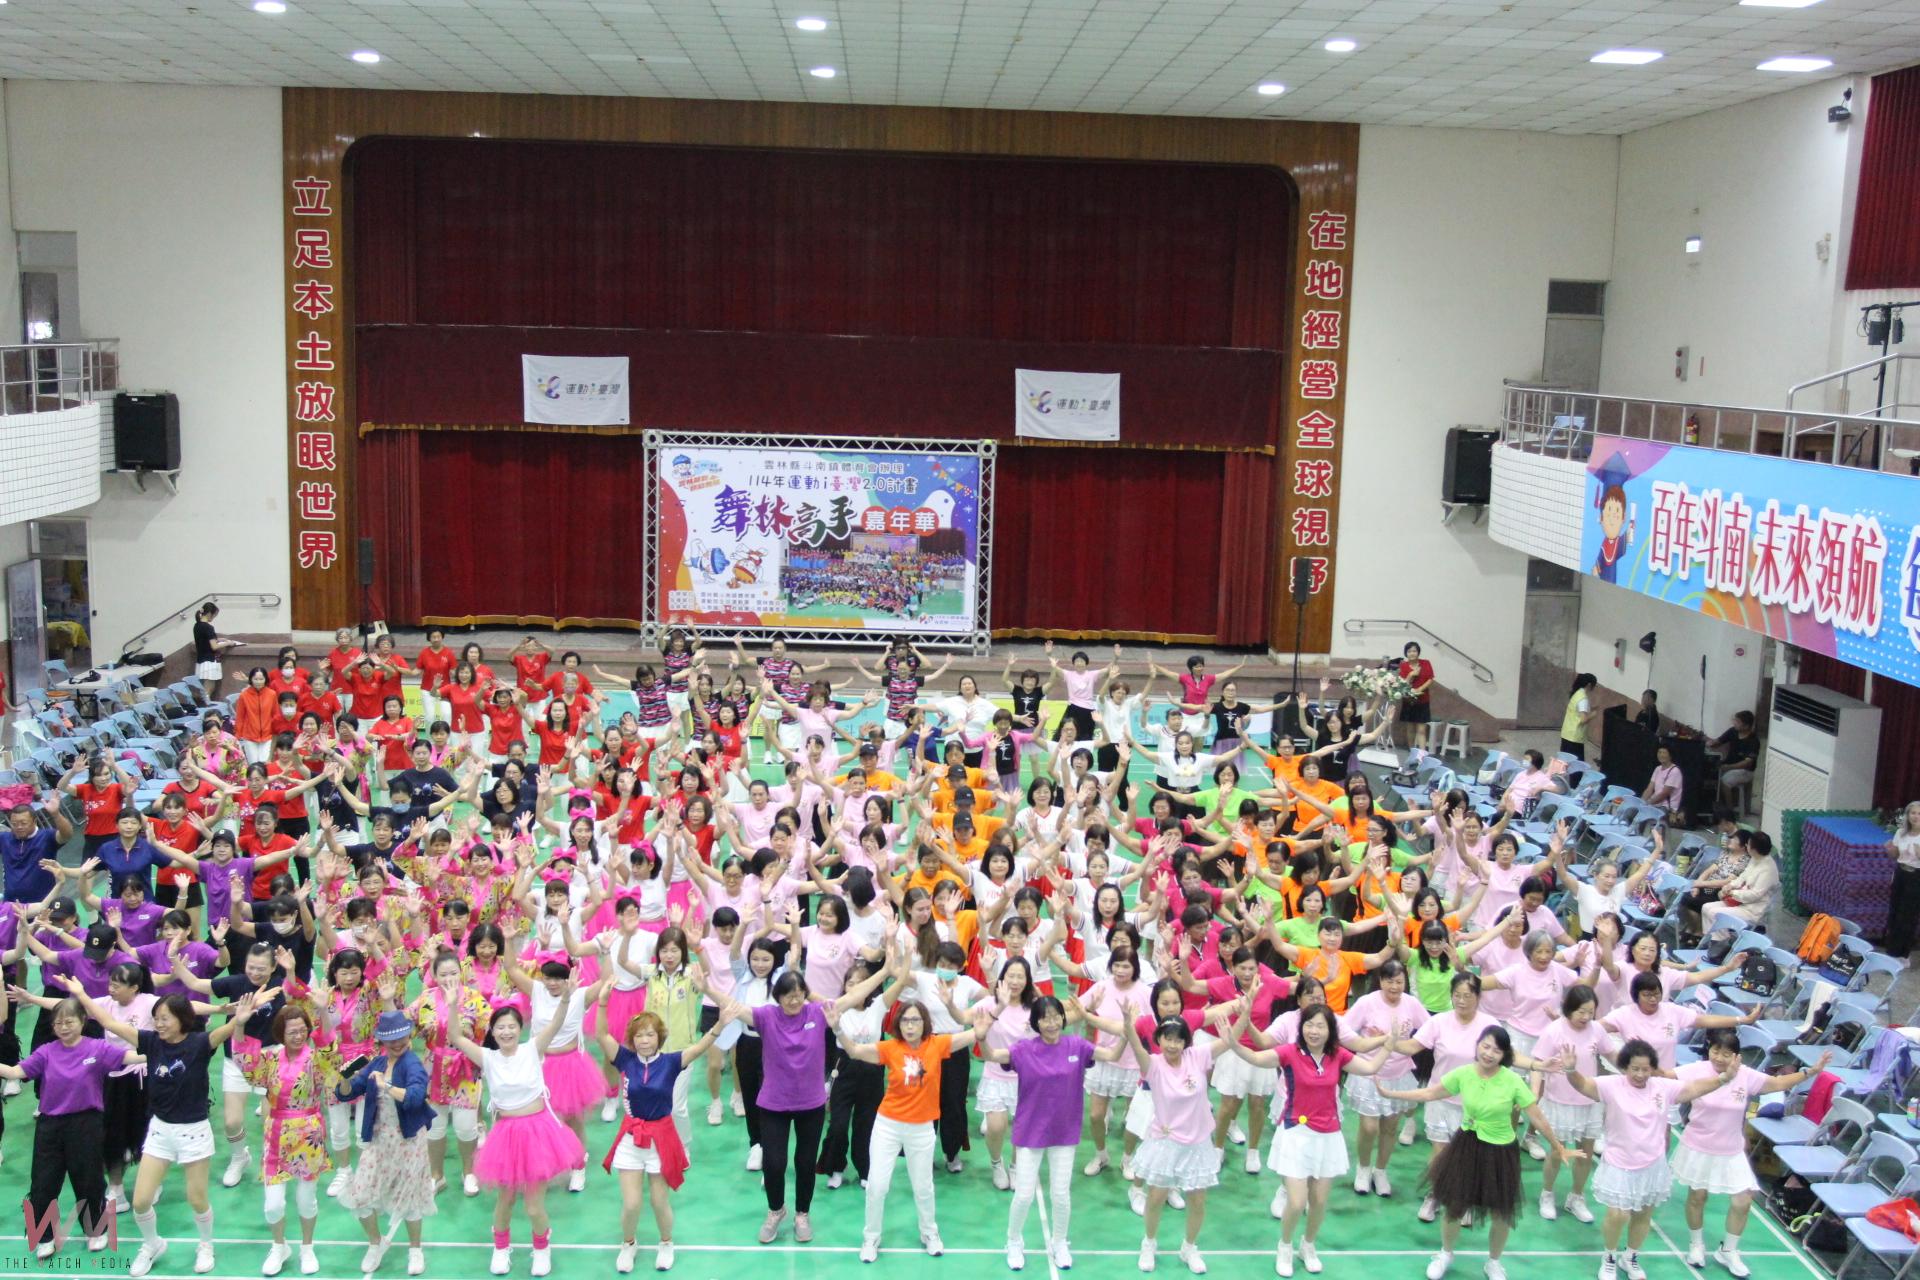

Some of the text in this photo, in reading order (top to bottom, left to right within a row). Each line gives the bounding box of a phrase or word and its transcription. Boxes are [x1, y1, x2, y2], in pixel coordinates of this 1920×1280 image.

[292, 175, 337, 570] 立足本土放眼世界
[1289, 209, 1347, 595] 在地經營全球視野
[711, 484, 857, 547] 舞林高手
[864, 510, 940, 534] 嘉年華
[1650, 484, 1750, 593] 百年斗南
[1752, 503, 1886, 632] 未來領航
